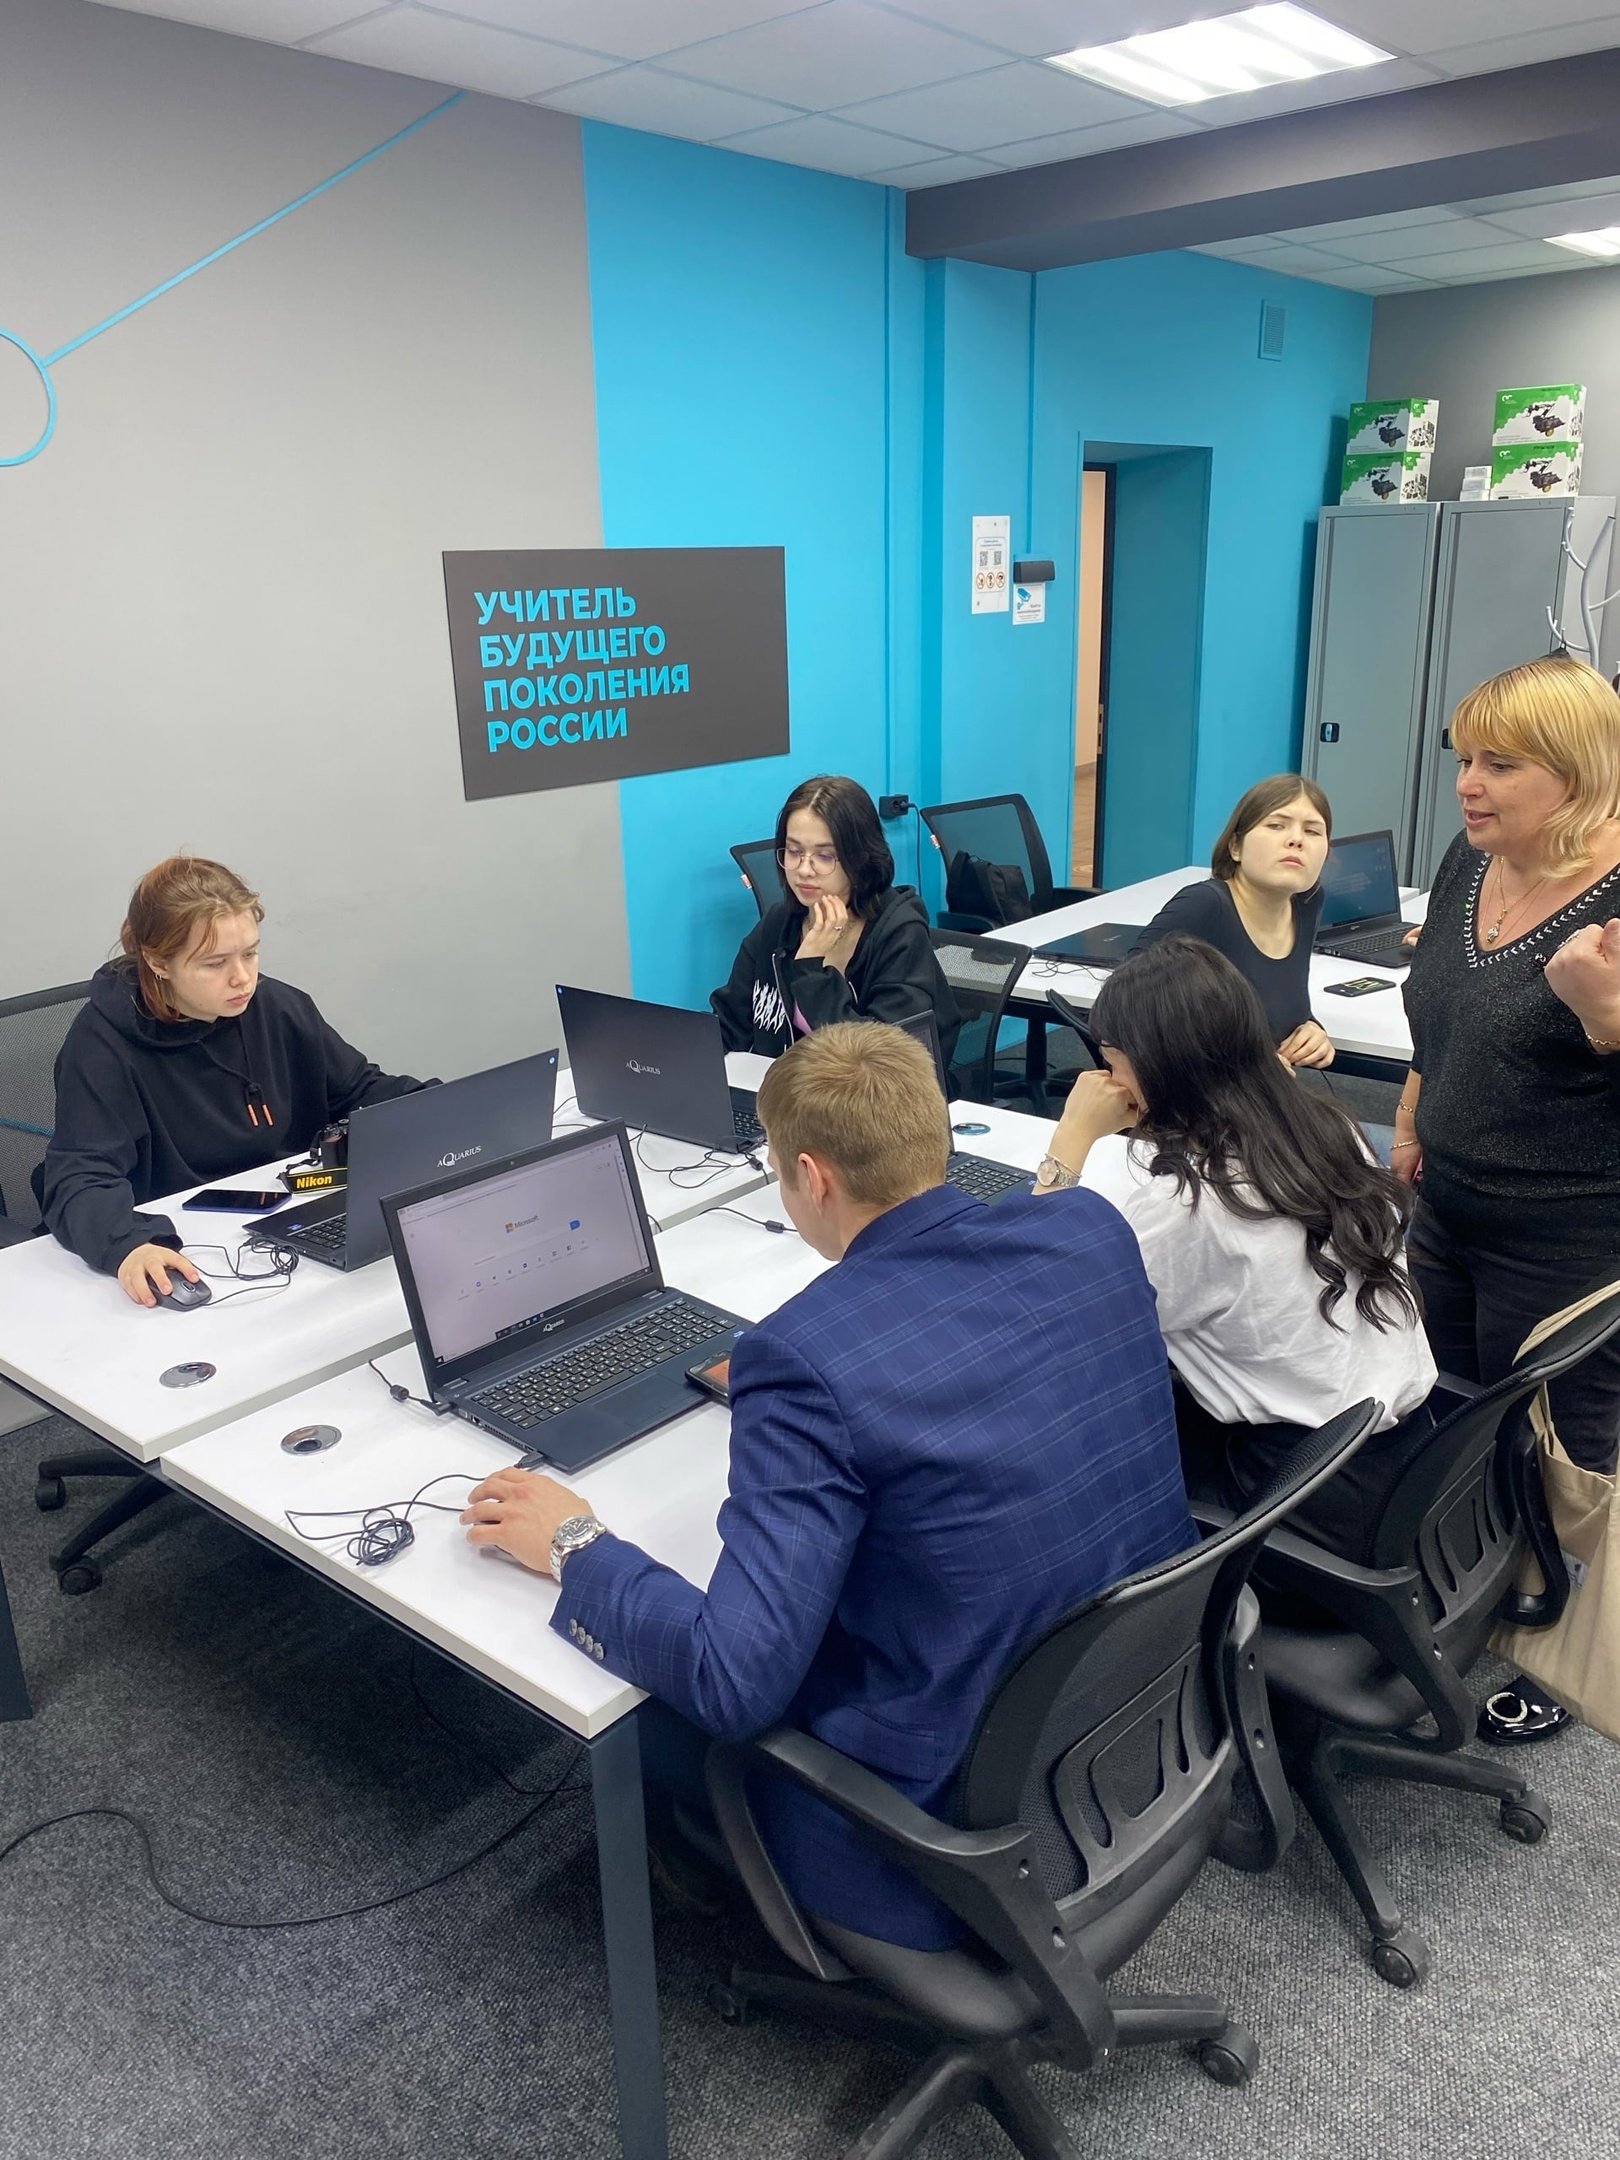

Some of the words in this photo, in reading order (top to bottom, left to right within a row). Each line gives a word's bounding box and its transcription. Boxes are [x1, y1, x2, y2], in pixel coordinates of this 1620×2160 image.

[474, 587, 636, 625] УЧИТЕЛЬ
[479, 625, 667, 670] БУДУЩЕГО
[484, 664, 690, 712] ПОКОЛЕНИЯ
[487, 708, 628, 752] РОССИИ
[437, 1145, 482, 1168] AQUARIUS
[296, 1174, 333, 1189] Nikon
